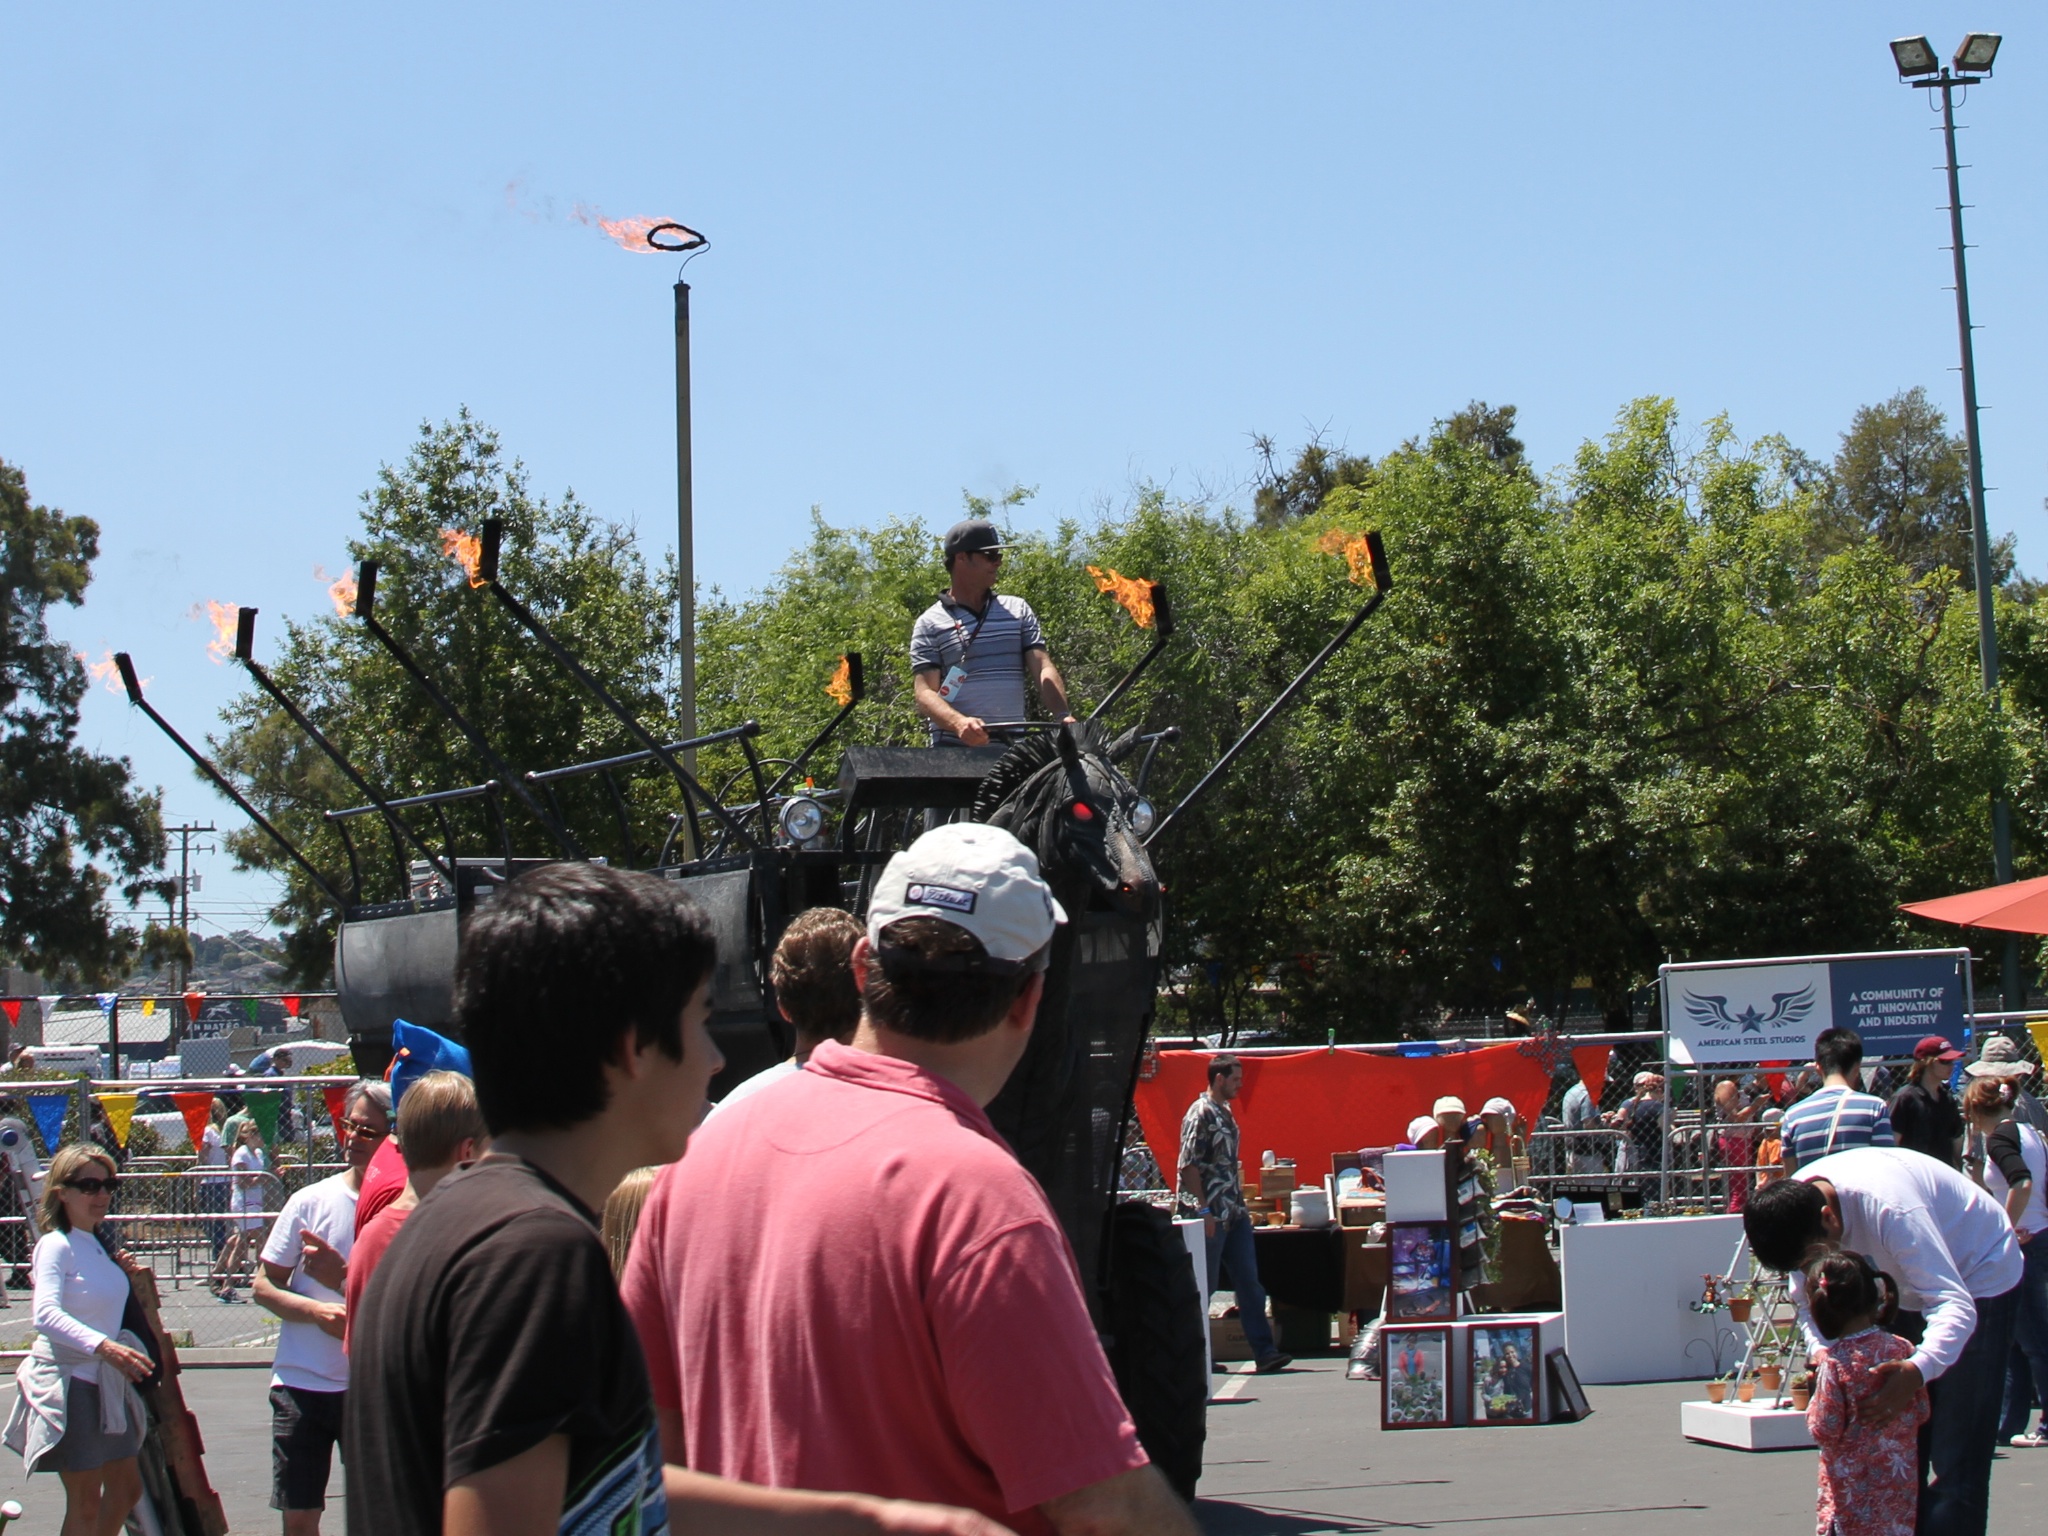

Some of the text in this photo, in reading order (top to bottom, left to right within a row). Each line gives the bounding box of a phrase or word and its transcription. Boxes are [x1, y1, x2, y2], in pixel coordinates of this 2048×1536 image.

[1849, 987, 1945, 1002] A COMMUNITY OF
[1850, 1000, 1942, 1015] ART, INNOVATION
[1858, 1013, 1938, 1028] AND INDUSTRY
[1697, 1035, 1806, 1047] AMERICAN STEEL STUDIOS
